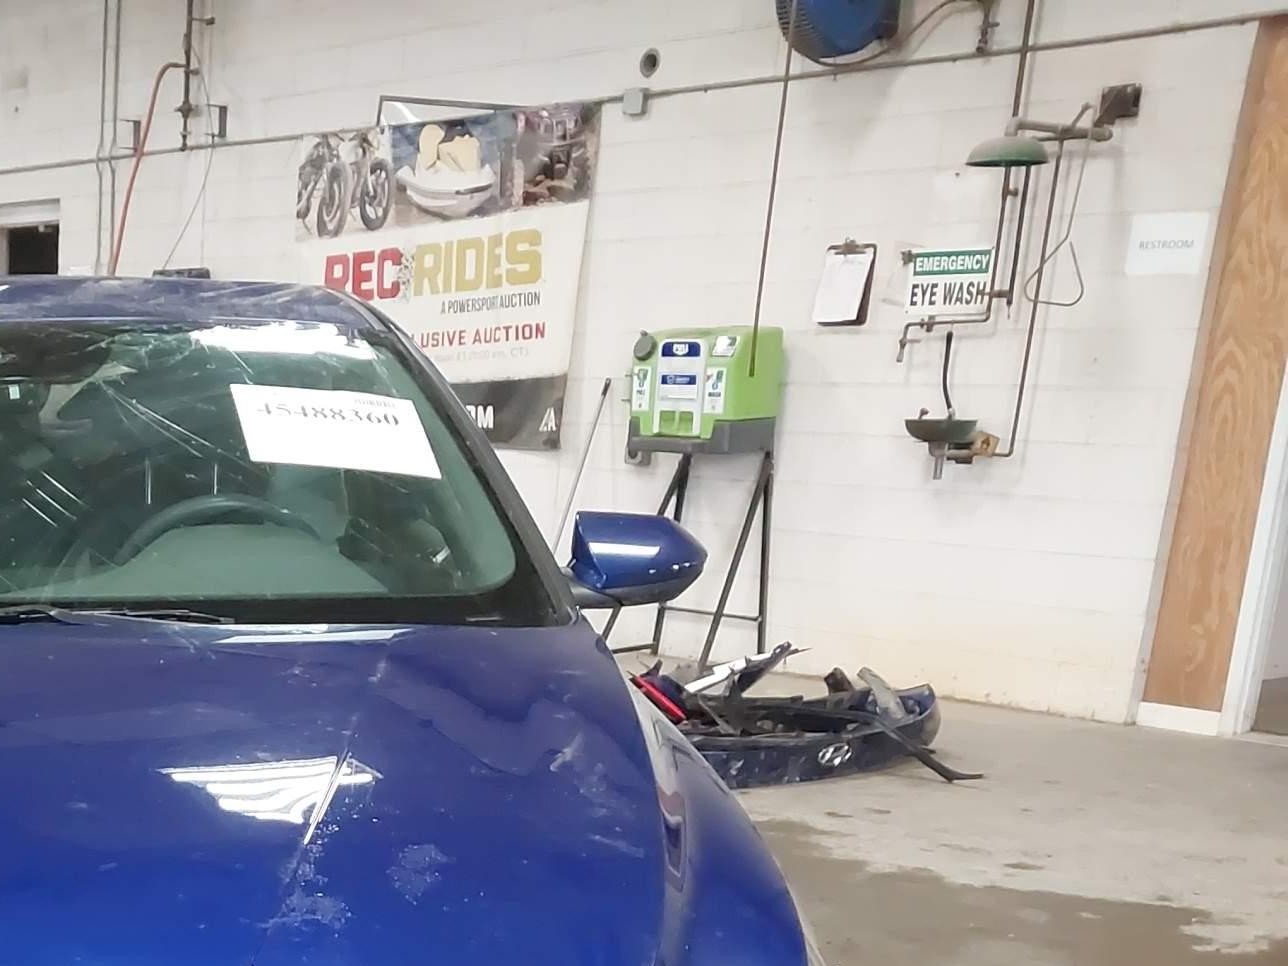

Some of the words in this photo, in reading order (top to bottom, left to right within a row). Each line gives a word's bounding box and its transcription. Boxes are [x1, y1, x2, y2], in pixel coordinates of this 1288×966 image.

[1138, 239, 1194, 249] RESTROOM
[413, 228, 543, 296] RIDES
[915, 254, 990, 272] EMERGENCY
[499, 291, 541, 309] AUCTION
[910, 282, 939, 306] EYE
[942, 281, 987, 306] WASH
[473, 321, 546, 345] AUCTION
